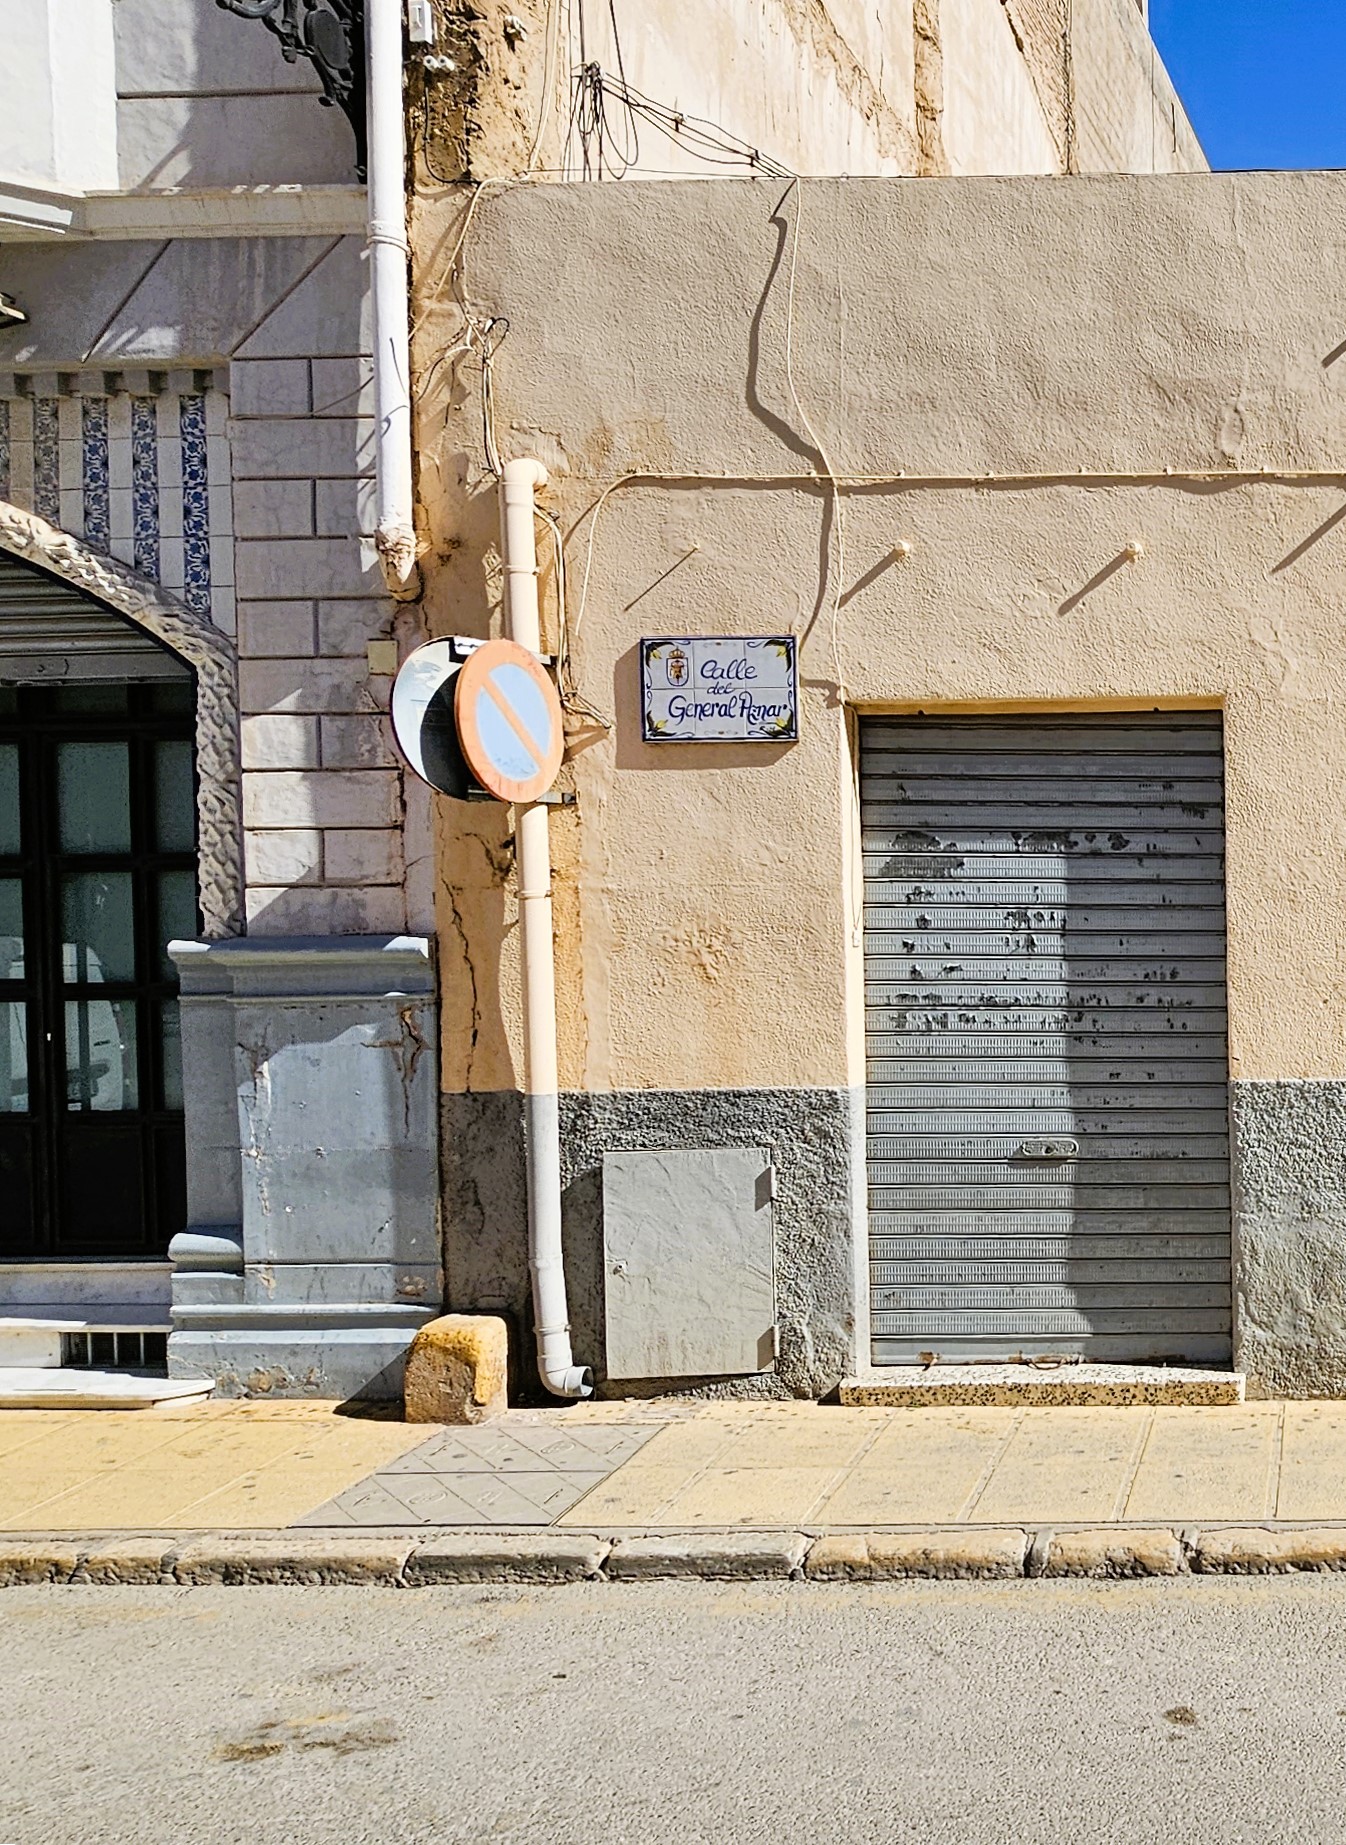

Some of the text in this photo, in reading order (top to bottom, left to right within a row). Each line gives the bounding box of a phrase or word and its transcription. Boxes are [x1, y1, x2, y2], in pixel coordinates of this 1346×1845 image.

[700, 659, 758, 680] Calle
[707, 681, 733, 694] del
[668, 690, 788, 725] General Aznar
